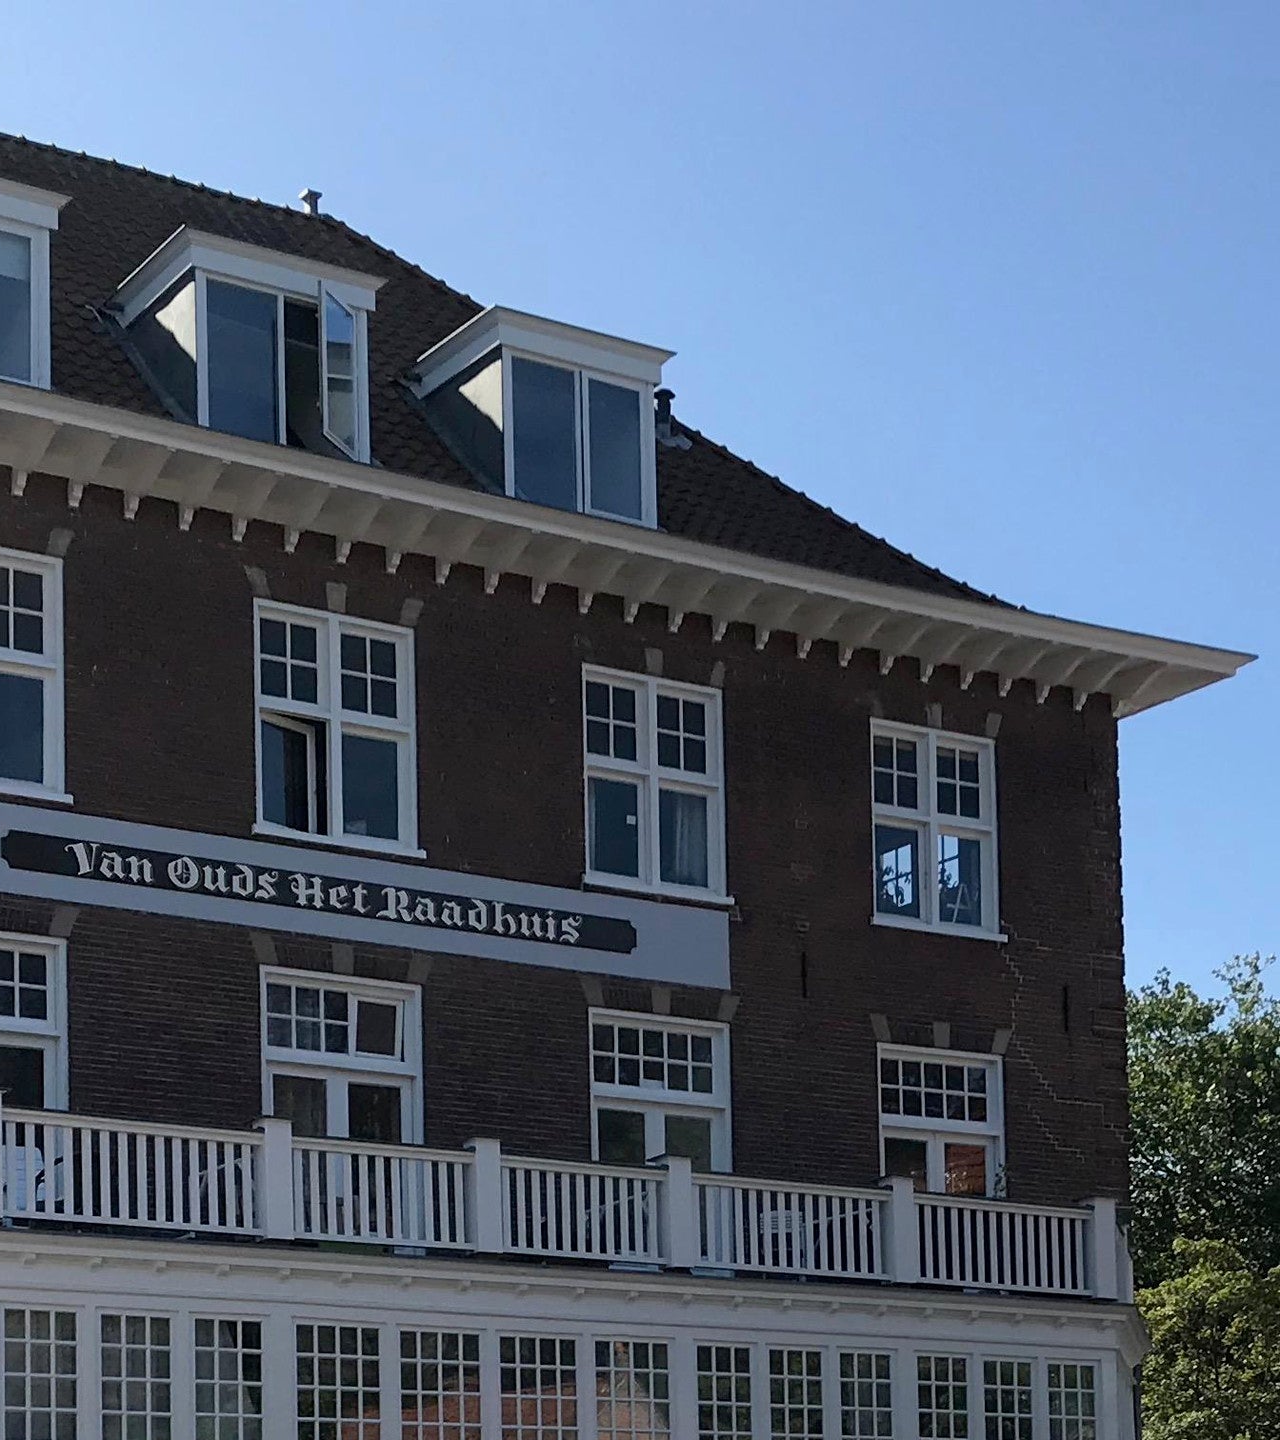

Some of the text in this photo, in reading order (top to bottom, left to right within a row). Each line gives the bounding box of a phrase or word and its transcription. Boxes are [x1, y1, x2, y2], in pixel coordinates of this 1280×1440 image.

[65, 842, 583, 944] Van Ouds Het Raadhuis
